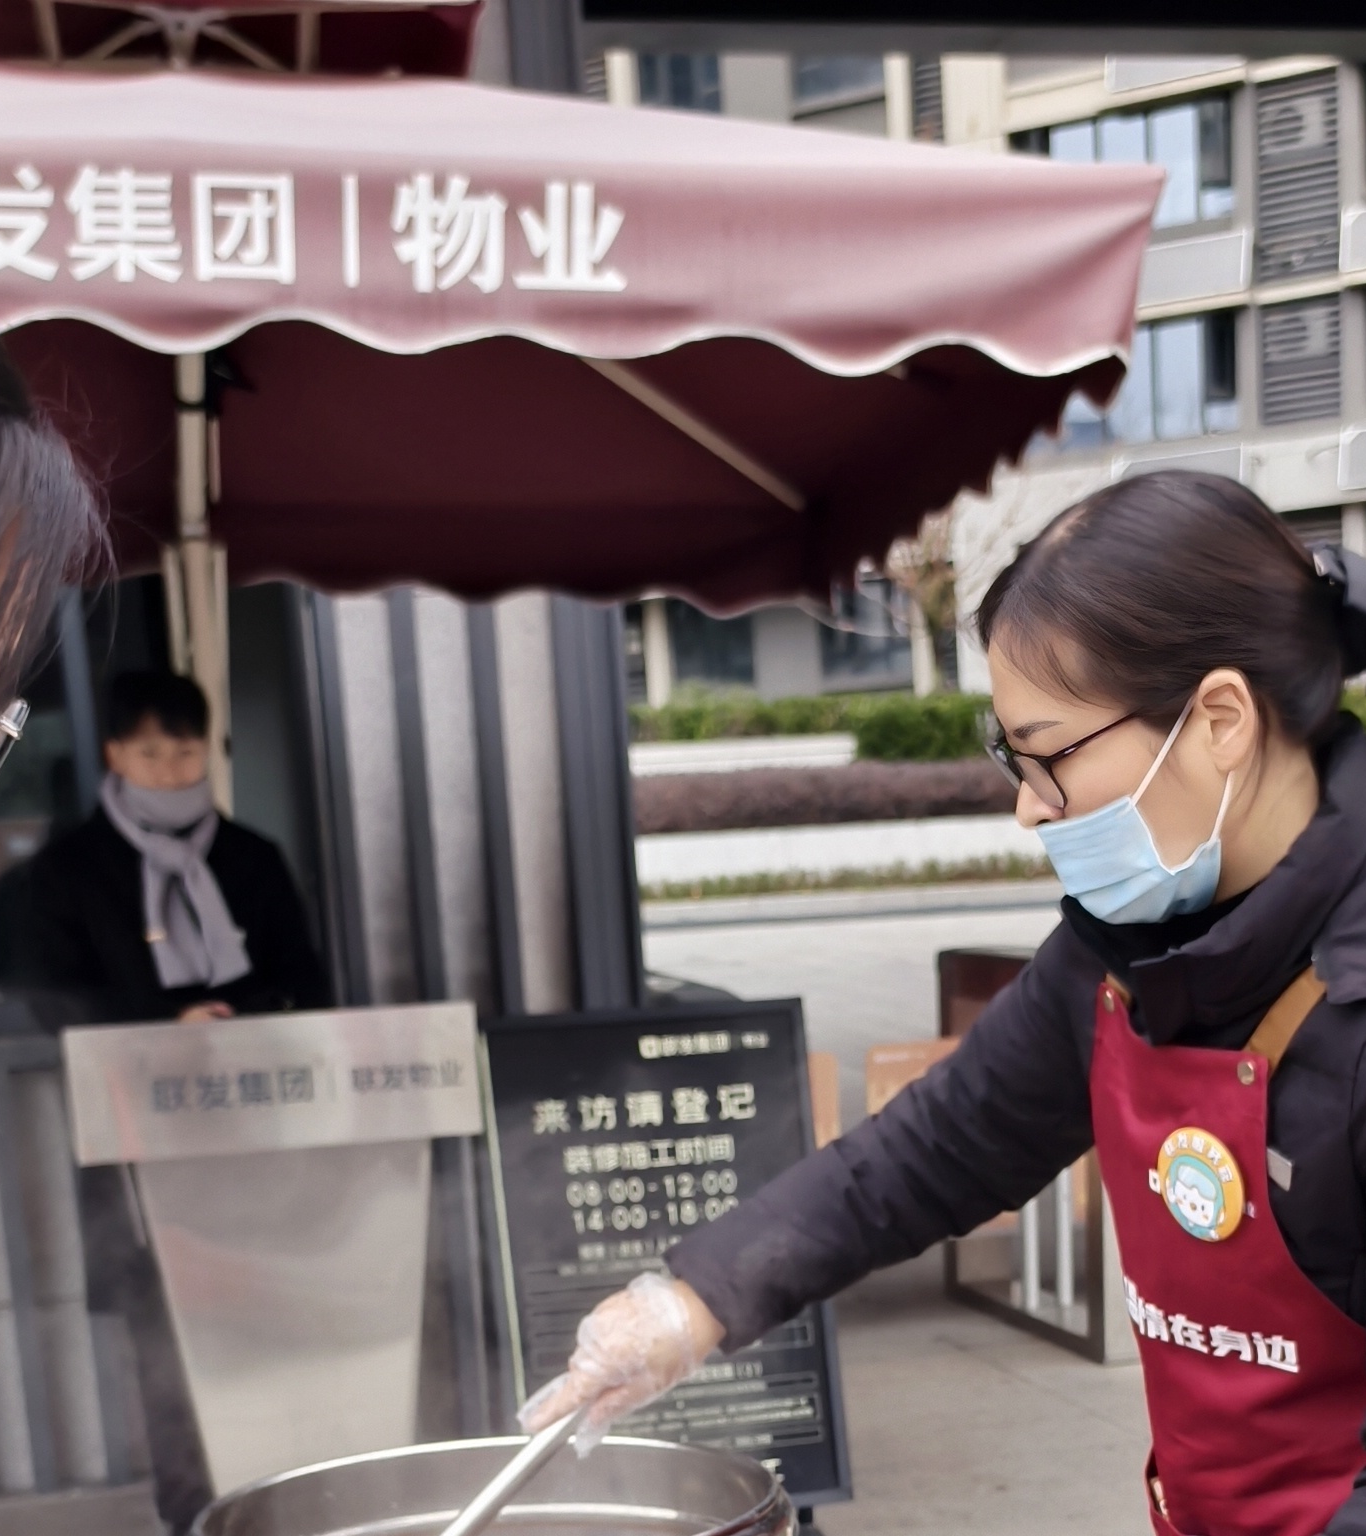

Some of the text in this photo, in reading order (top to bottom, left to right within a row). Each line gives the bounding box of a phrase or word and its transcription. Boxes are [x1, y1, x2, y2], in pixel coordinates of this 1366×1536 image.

[392, 173, 628, 293] 物业
[533, 1083, 757, 1134] 来访请登记
